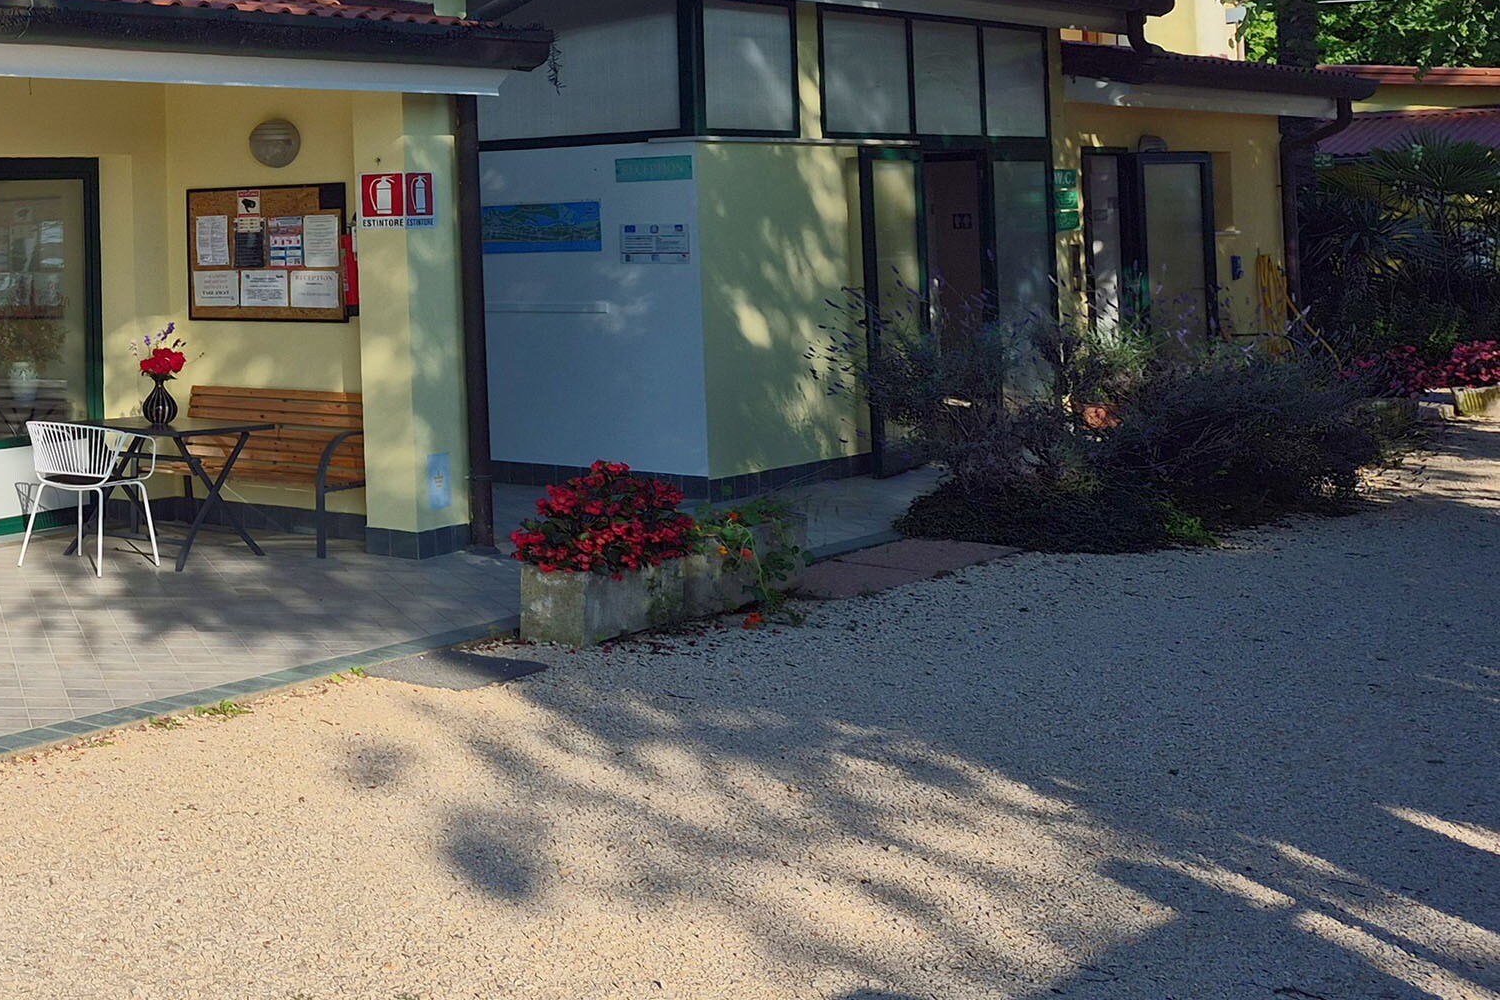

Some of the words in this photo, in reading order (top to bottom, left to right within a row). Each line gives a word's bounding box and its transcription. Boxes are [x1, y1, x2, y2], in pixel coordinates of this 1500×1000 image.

[1053, 171, 1075, 185] W.C.
[362, 218, 404, 228] ESTINTORE
[406, 217, 434, 226] ESTINTORE
